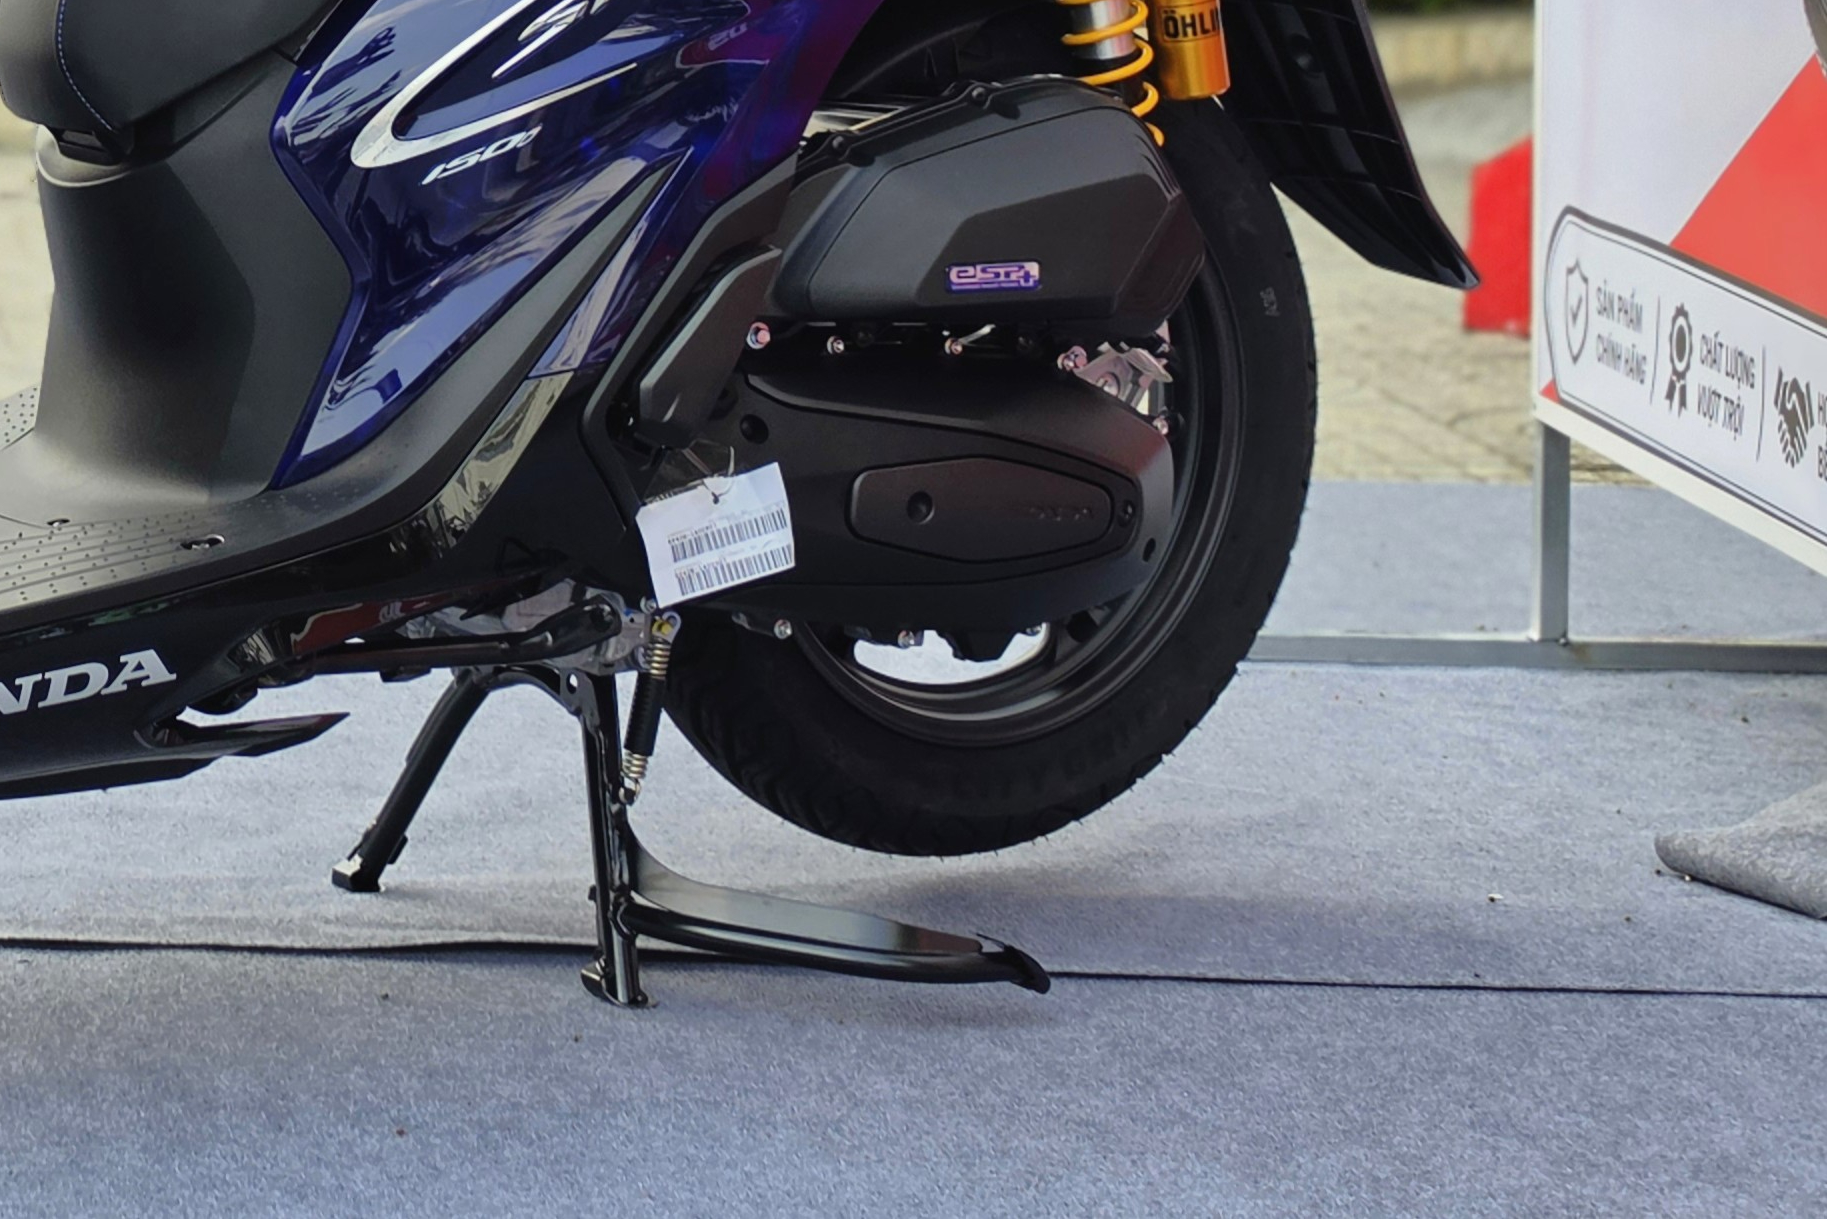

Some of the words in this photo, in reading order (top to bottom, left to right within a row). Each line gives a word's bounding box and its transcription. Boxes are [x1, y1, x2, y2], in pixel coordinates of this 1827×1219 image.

[1700, 331, 1723, 373] CHẤT
[1726, 345, 1755, 390] LƯỢNG
[1697, 383, 1722, 428] VƯỢT
